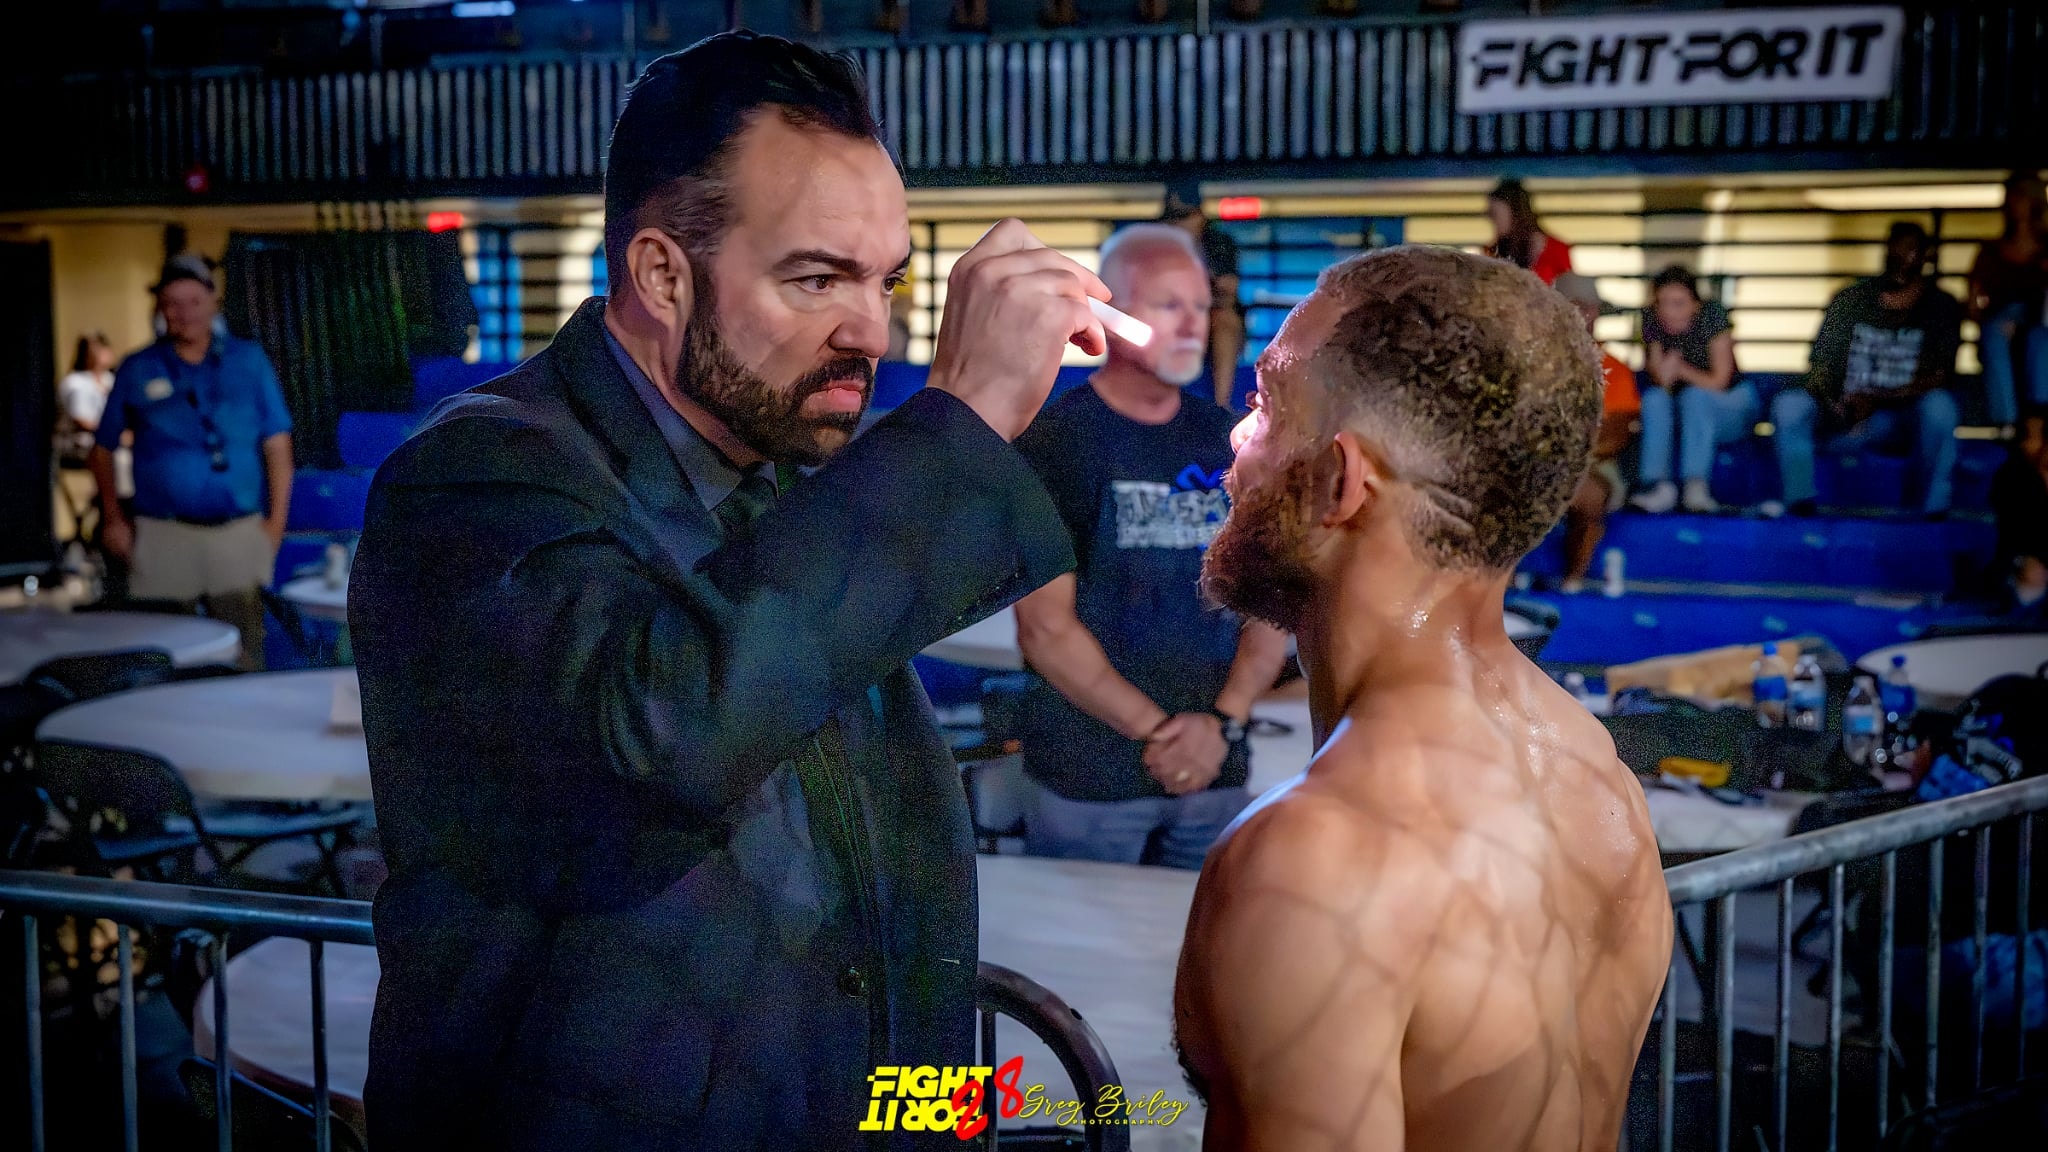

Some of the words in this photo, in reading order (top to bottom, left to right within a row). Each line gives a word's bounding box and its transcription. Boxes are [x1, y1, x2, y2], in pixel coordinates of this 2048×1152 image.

[1470, 34, 1669, 89] FIGHT
[1672, 28, 1808, 83] FOR
[1815, 23, 1884, 77] IT
